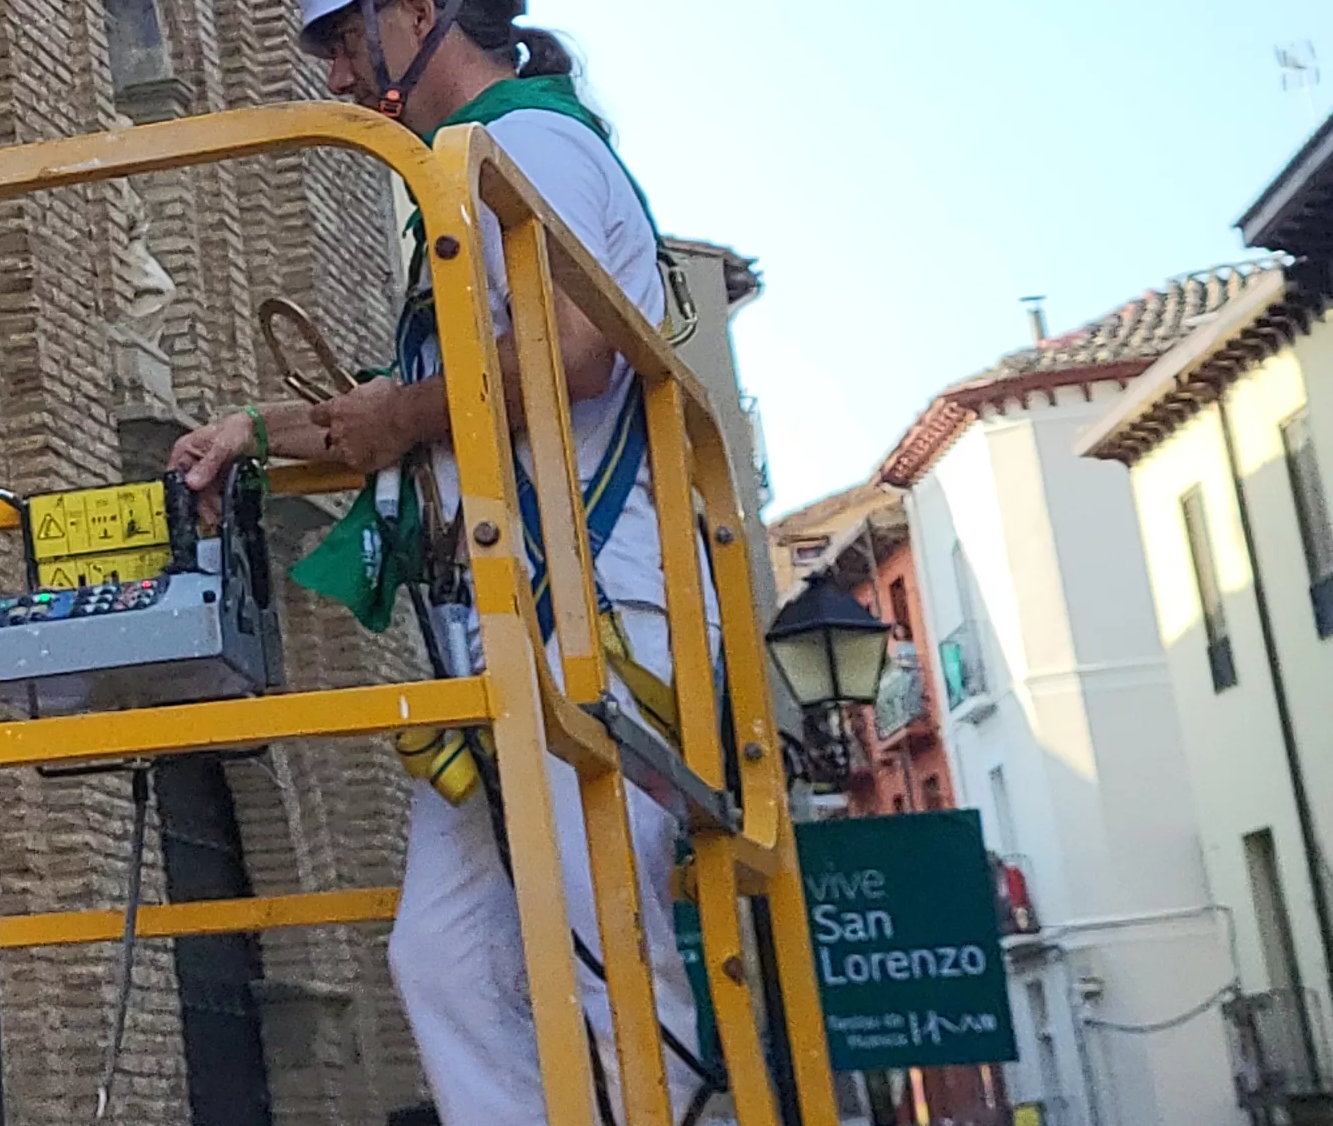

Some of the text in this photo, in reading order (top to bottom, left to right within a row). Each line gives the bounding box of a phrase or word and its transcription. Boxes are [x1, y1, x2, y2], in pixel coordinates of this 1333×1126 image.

[804, 860, 888, 901] vive
[811, 903, 894, 945] San
[818, 944, 988, 987] Lorenzo
